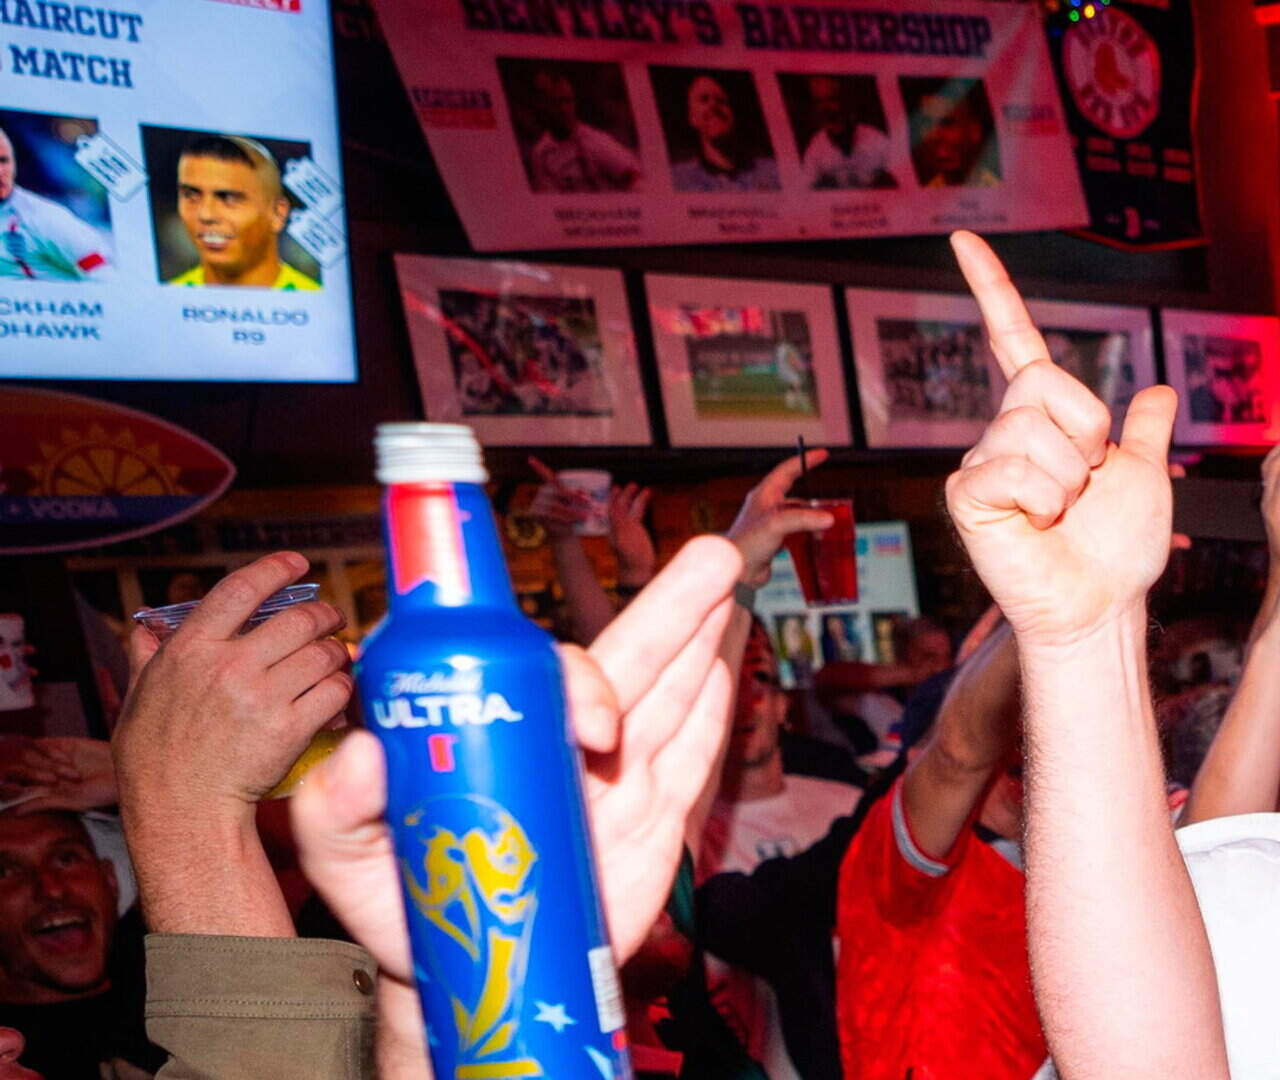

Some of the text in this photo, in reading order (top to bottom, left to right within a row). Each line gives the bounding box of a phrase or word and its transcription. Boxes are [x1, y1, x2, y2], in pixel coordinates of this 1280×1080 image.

[740, 2, 992, 57] BARBERSHOP
[9, 44, 133, 88] MATCH
[182, 305, 310, 326] RONALDO
[233, 328, 267, 345] R9
[31, 502, 118, 518] VODKA
[373, 692, 524, 729] ULTRA
